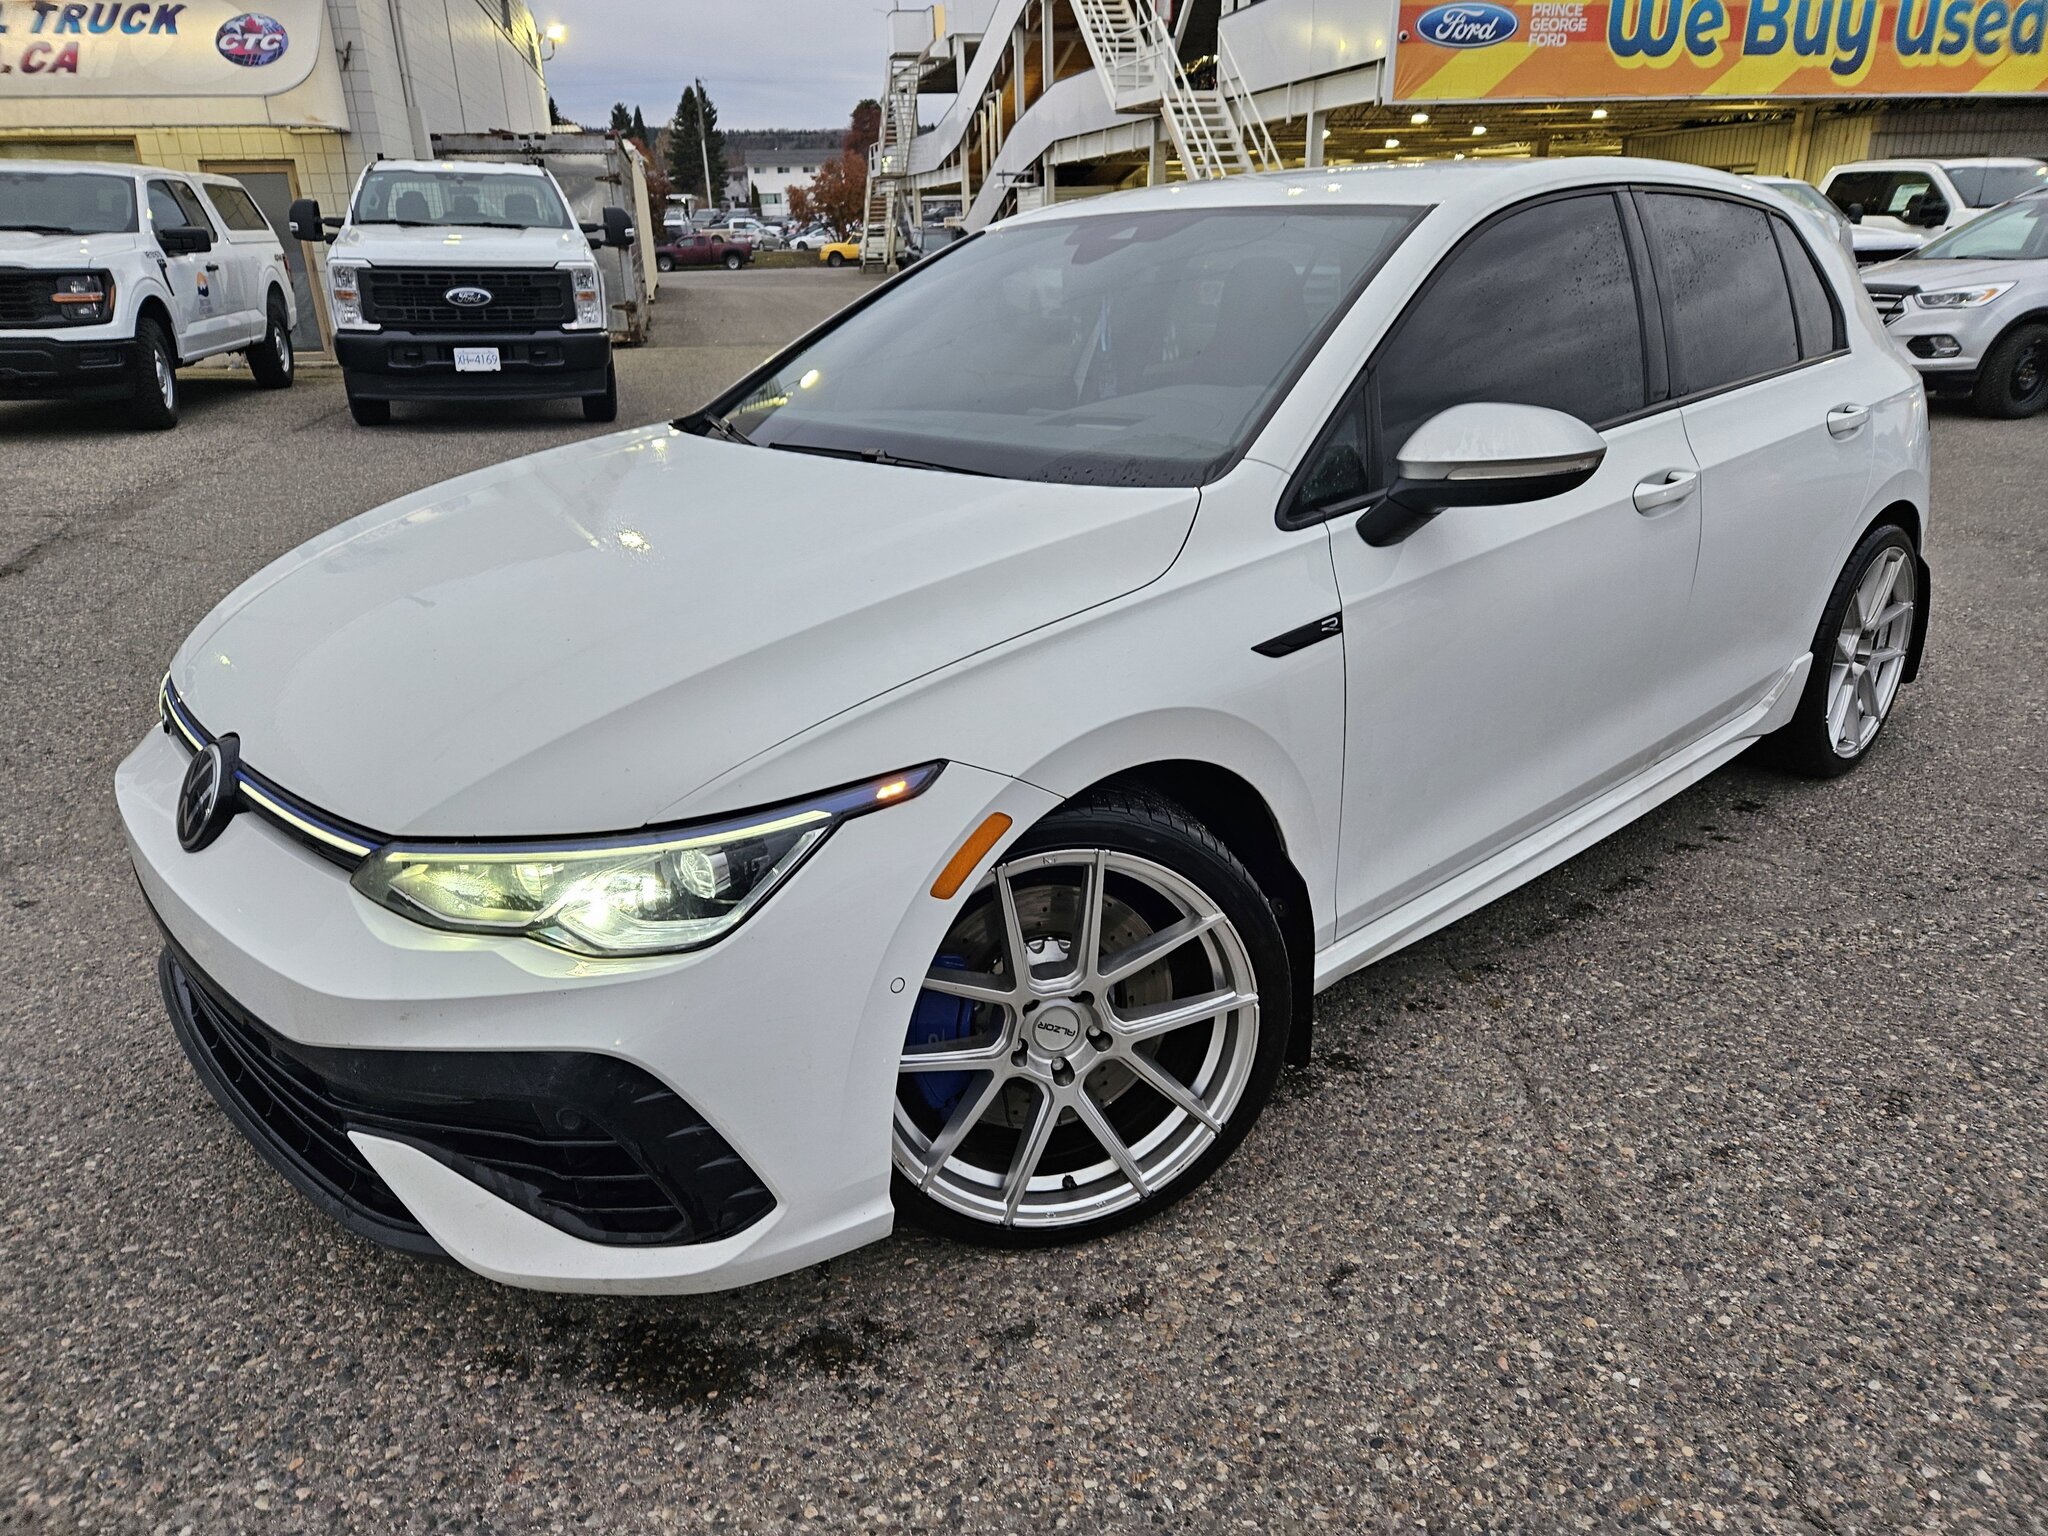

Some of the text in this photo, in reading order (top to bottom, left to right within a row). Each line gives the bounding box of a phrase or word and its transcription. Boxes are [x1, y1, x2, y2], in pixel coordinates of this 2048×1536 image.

[31, 1, 187, 34] TRUCK
[1531, 3, 1584, 17] PRINCE
[1435, 8, 1500, 41] Ford
[1529, 18, 1588, 32] GEORGE
[218, 33, 284, 50] CTC
[1528, 33, 1568, 47] FORD
[1607, 0, 1726, 59] We
[1742, 0, 1877, 76] Buy
